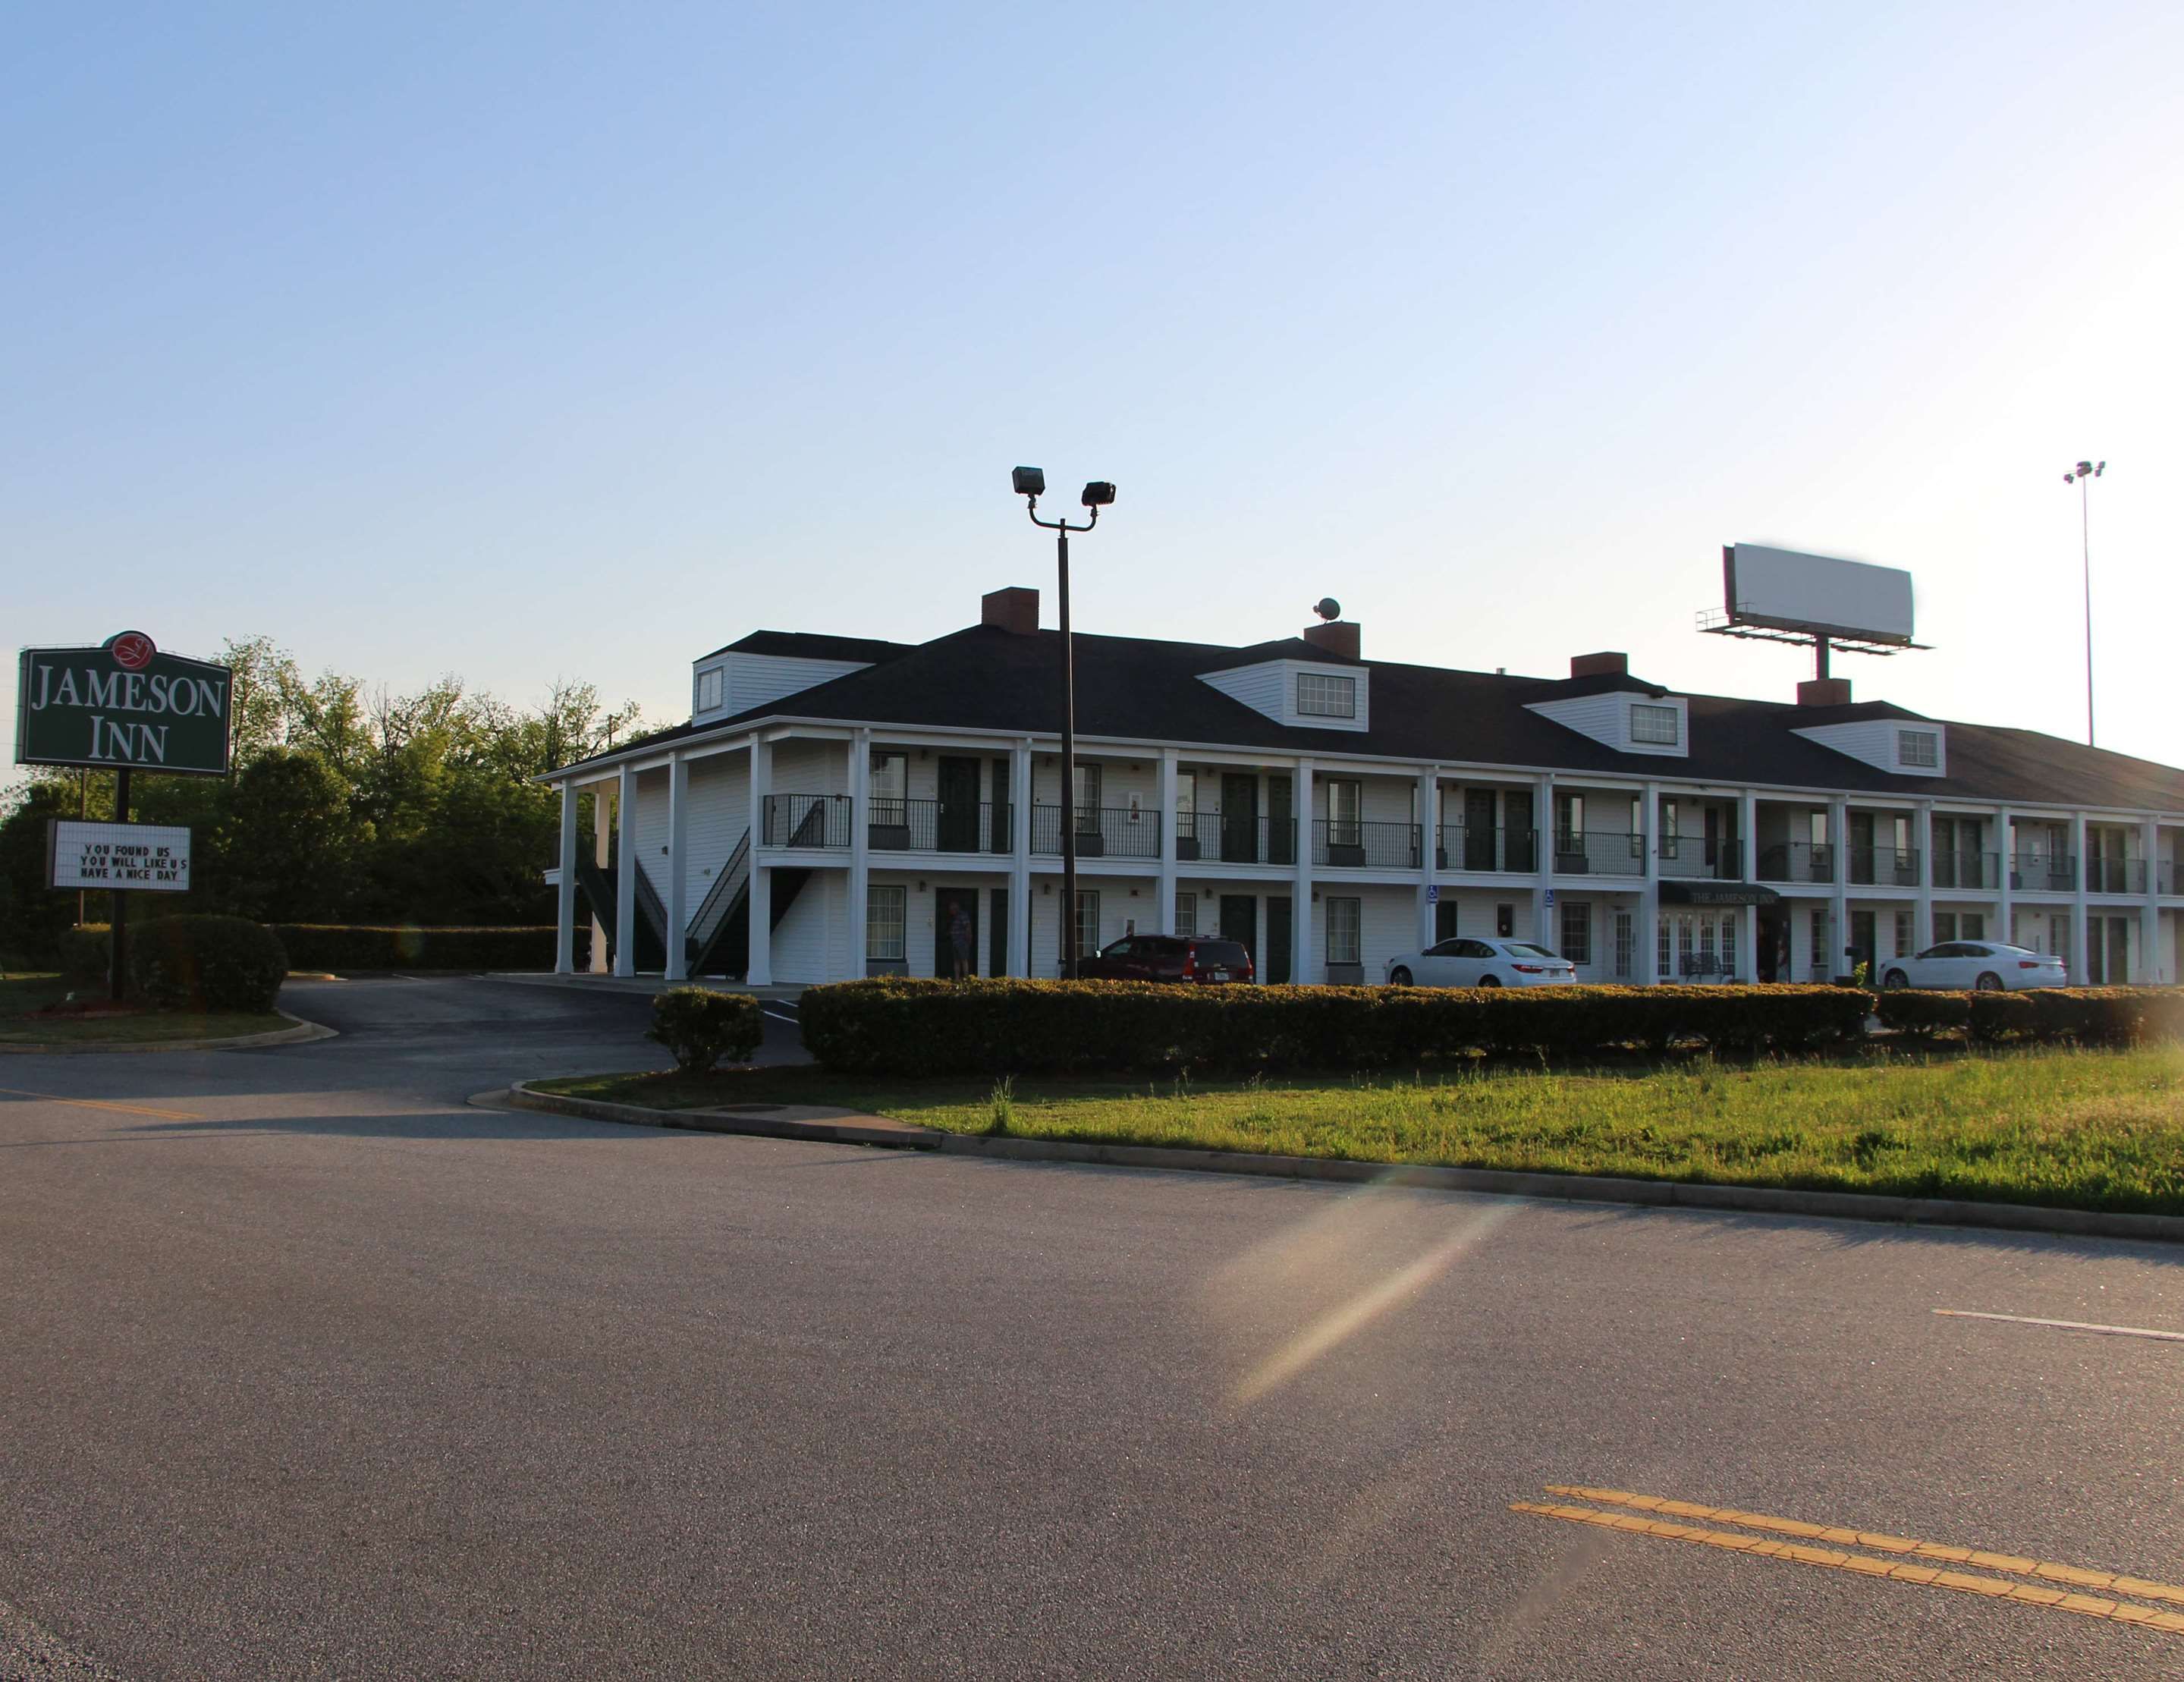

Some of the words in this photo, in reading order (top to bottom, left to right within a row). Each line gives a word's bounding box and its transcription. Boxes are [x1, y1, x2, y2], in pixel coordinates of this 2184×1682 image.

[31, 665, 225, 718] JAMESON
[88, 715, 169, 762] INN
[85, 844, 110, 855] YOU
[115, 845, 149, 857] FOUND
[156, 847, 170, 857] US
[80, 856, 106, 866] YOU
[112, 857, 137, 867] WILL
[144, 859, 167, 869] LIKE
[80, 868, 108, 878] HAVE
[115, 869, 122, 879] A
[127, 869, 150, 879] NICE
[157, 870, 178, 880] DAY
[1692, 892, 1712, 904] THE
